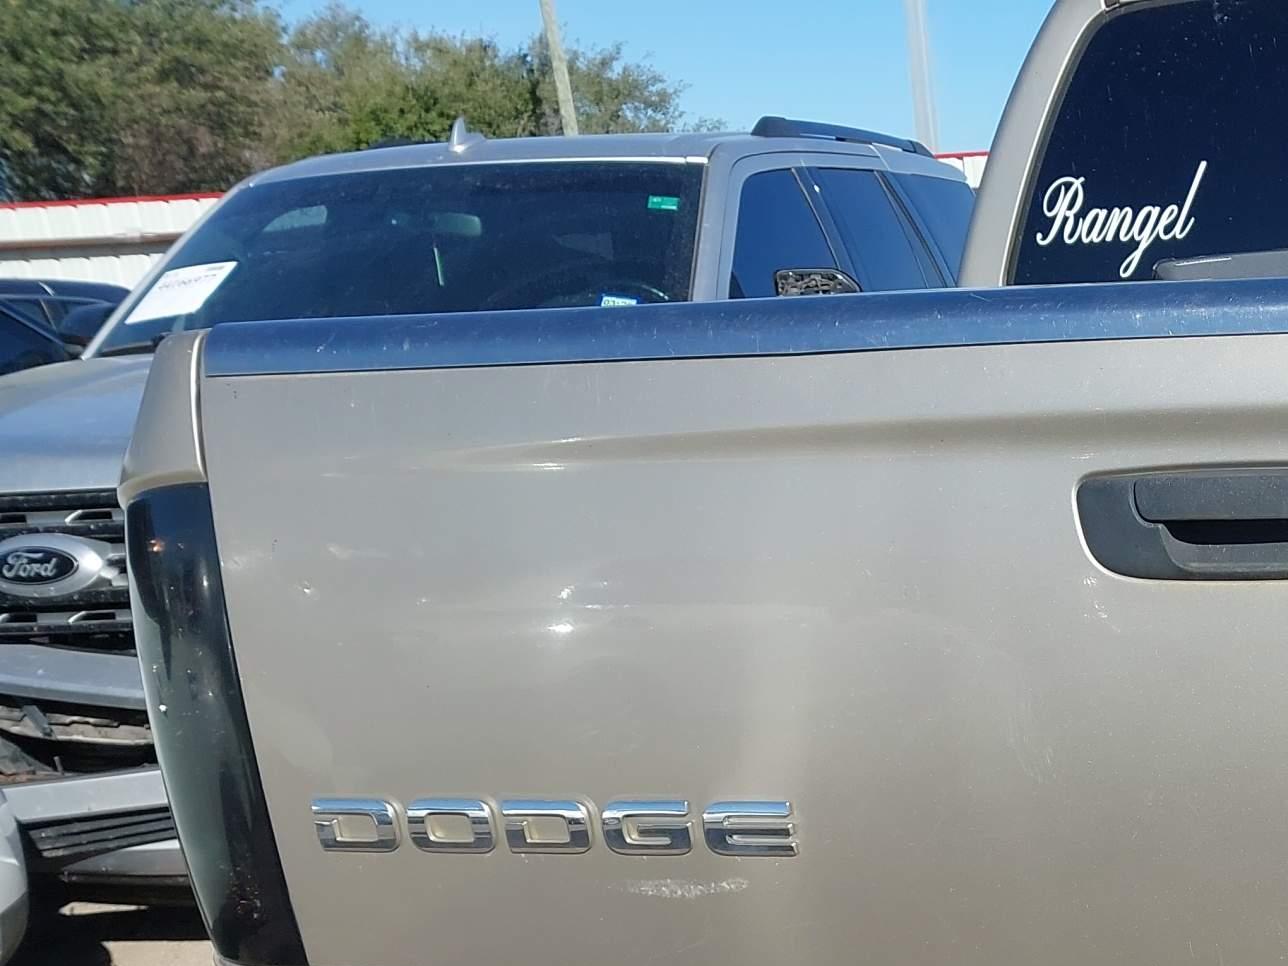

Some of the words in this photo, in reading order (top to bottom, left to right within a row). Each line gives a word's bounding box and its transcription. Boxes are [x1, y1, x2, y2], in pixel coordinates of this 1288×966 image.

[1036, 160, 1207, 278] Rangel
[2, 551, 58, 578] Ford
[311, 797, 799, 858] DODGE
